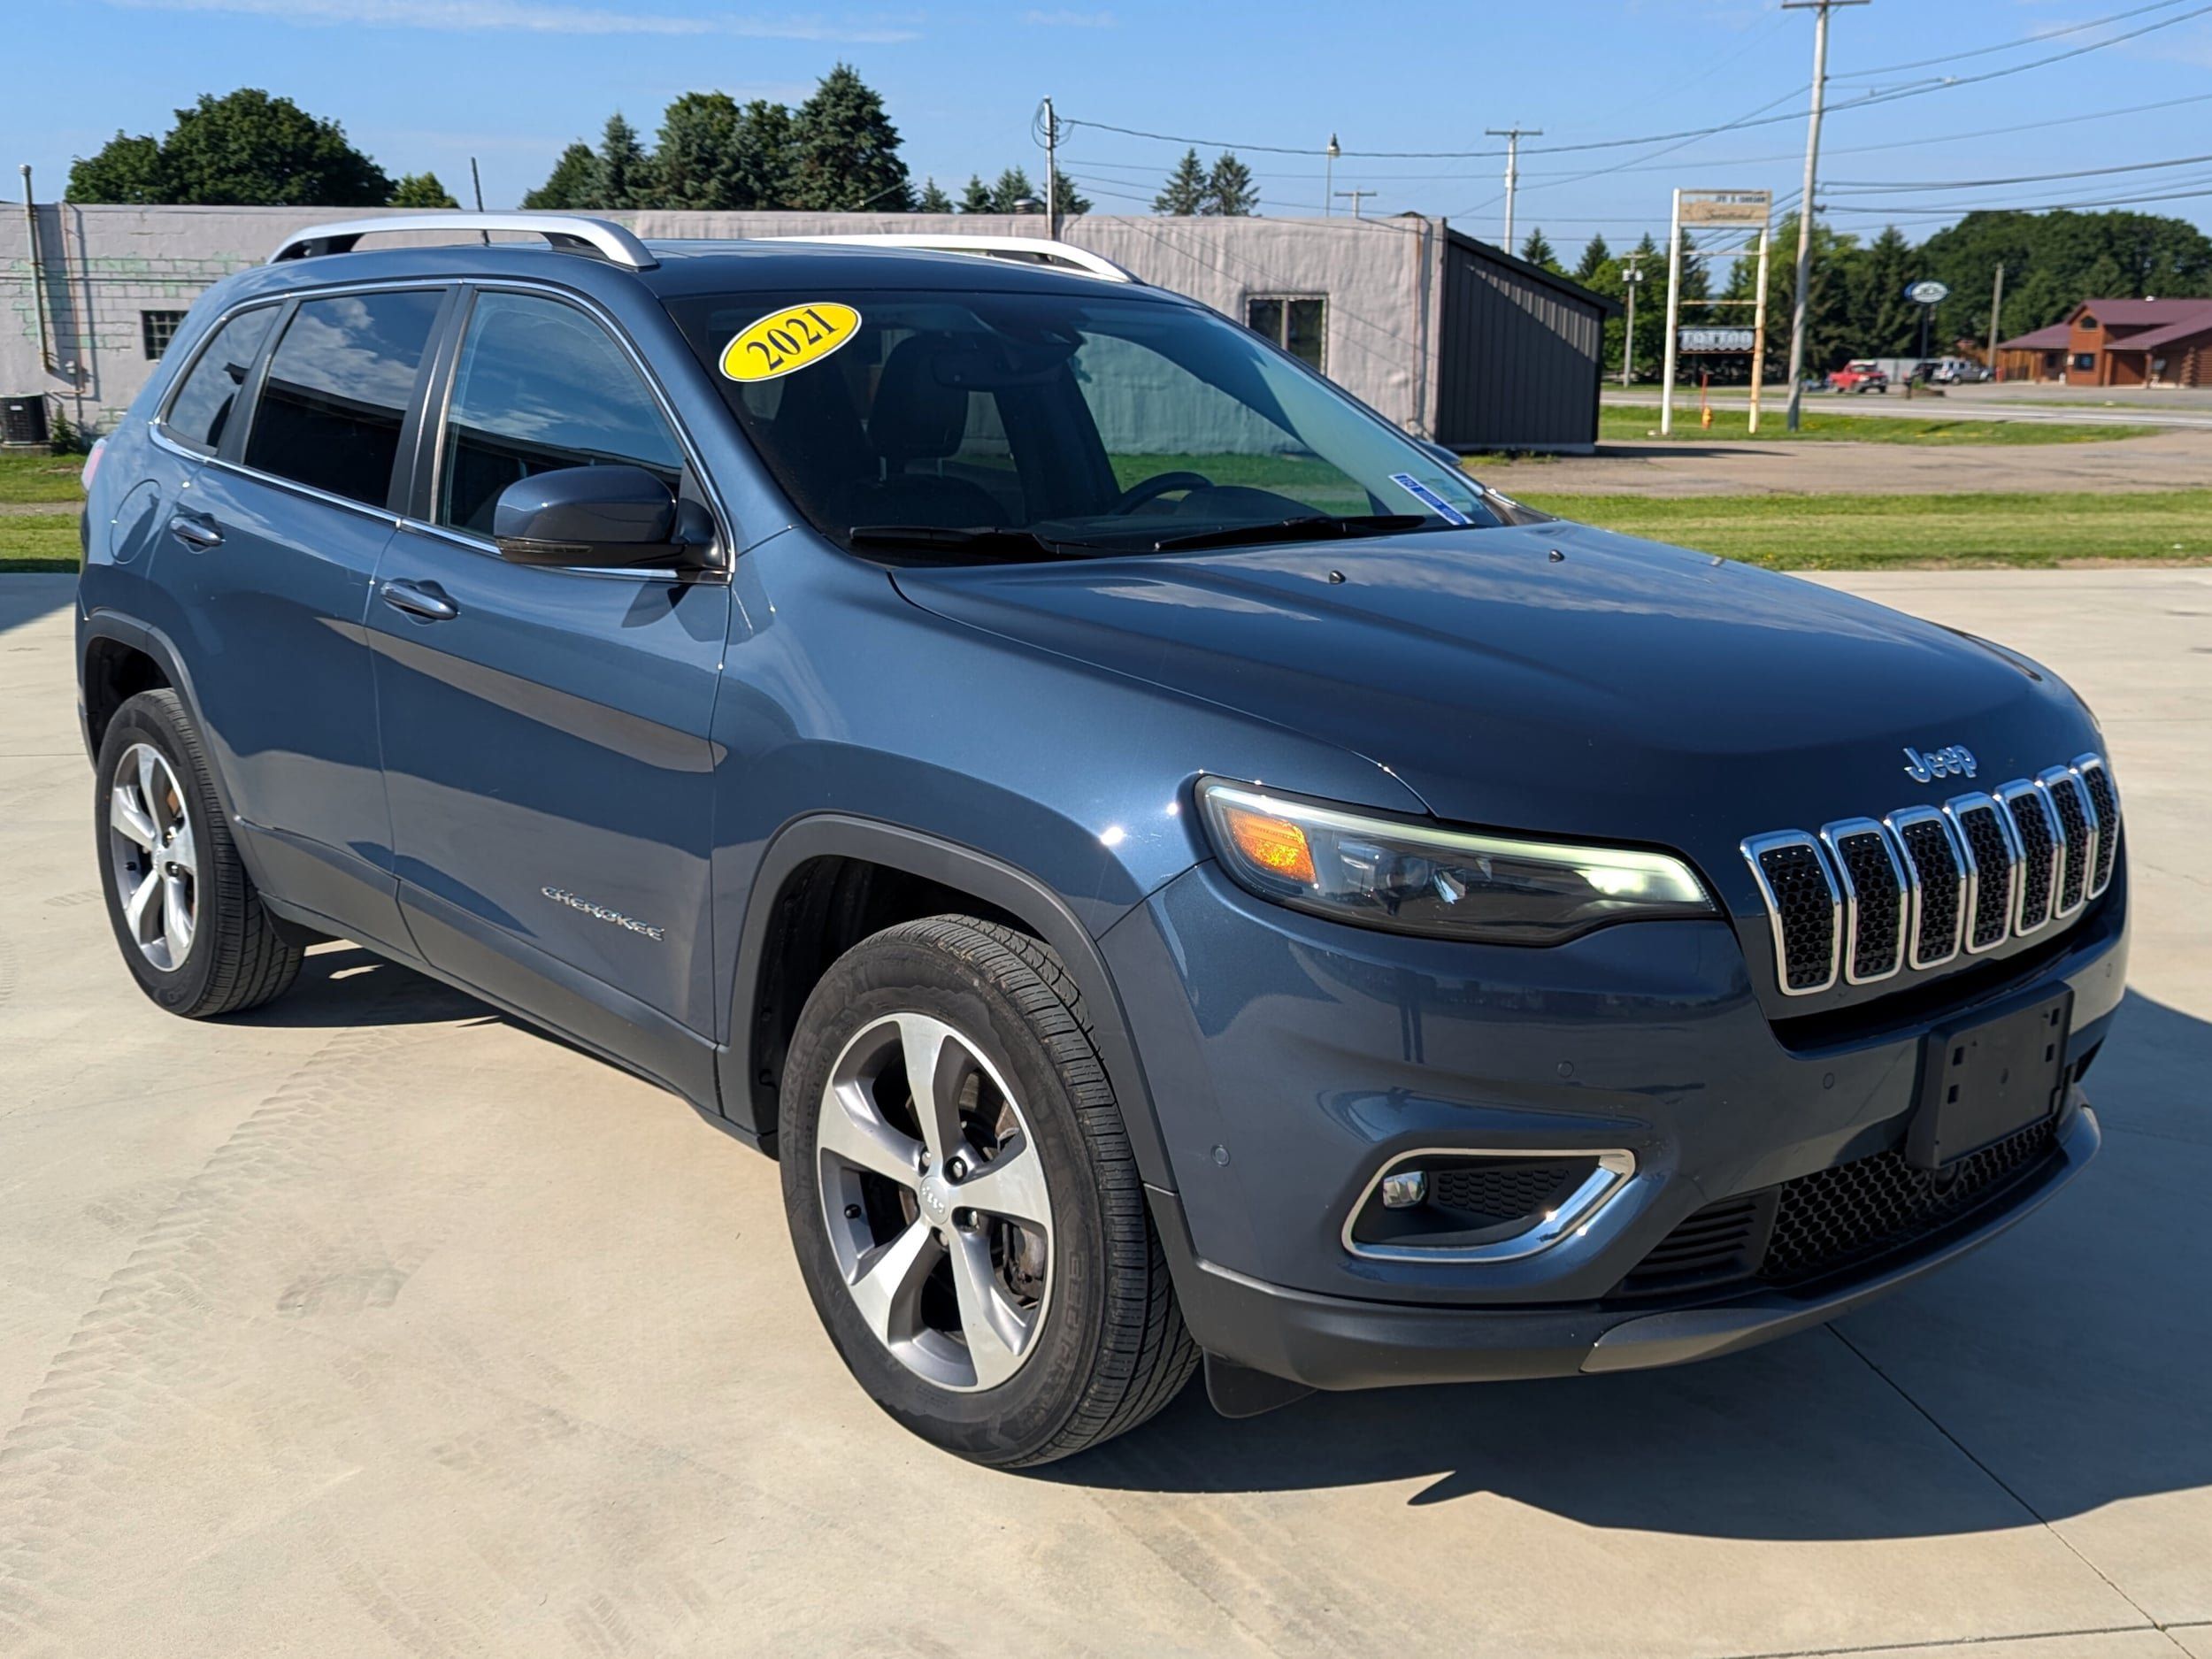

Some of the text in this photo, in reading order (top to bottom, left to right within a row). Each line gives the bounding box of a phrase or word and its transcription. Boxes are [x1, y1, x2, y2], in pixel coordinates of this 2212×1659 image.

[746, 308, 840, 372] 2021
[1902, 745, 1978, 783] Jeep
[541, 886, 664, 941] CHEROKEE
